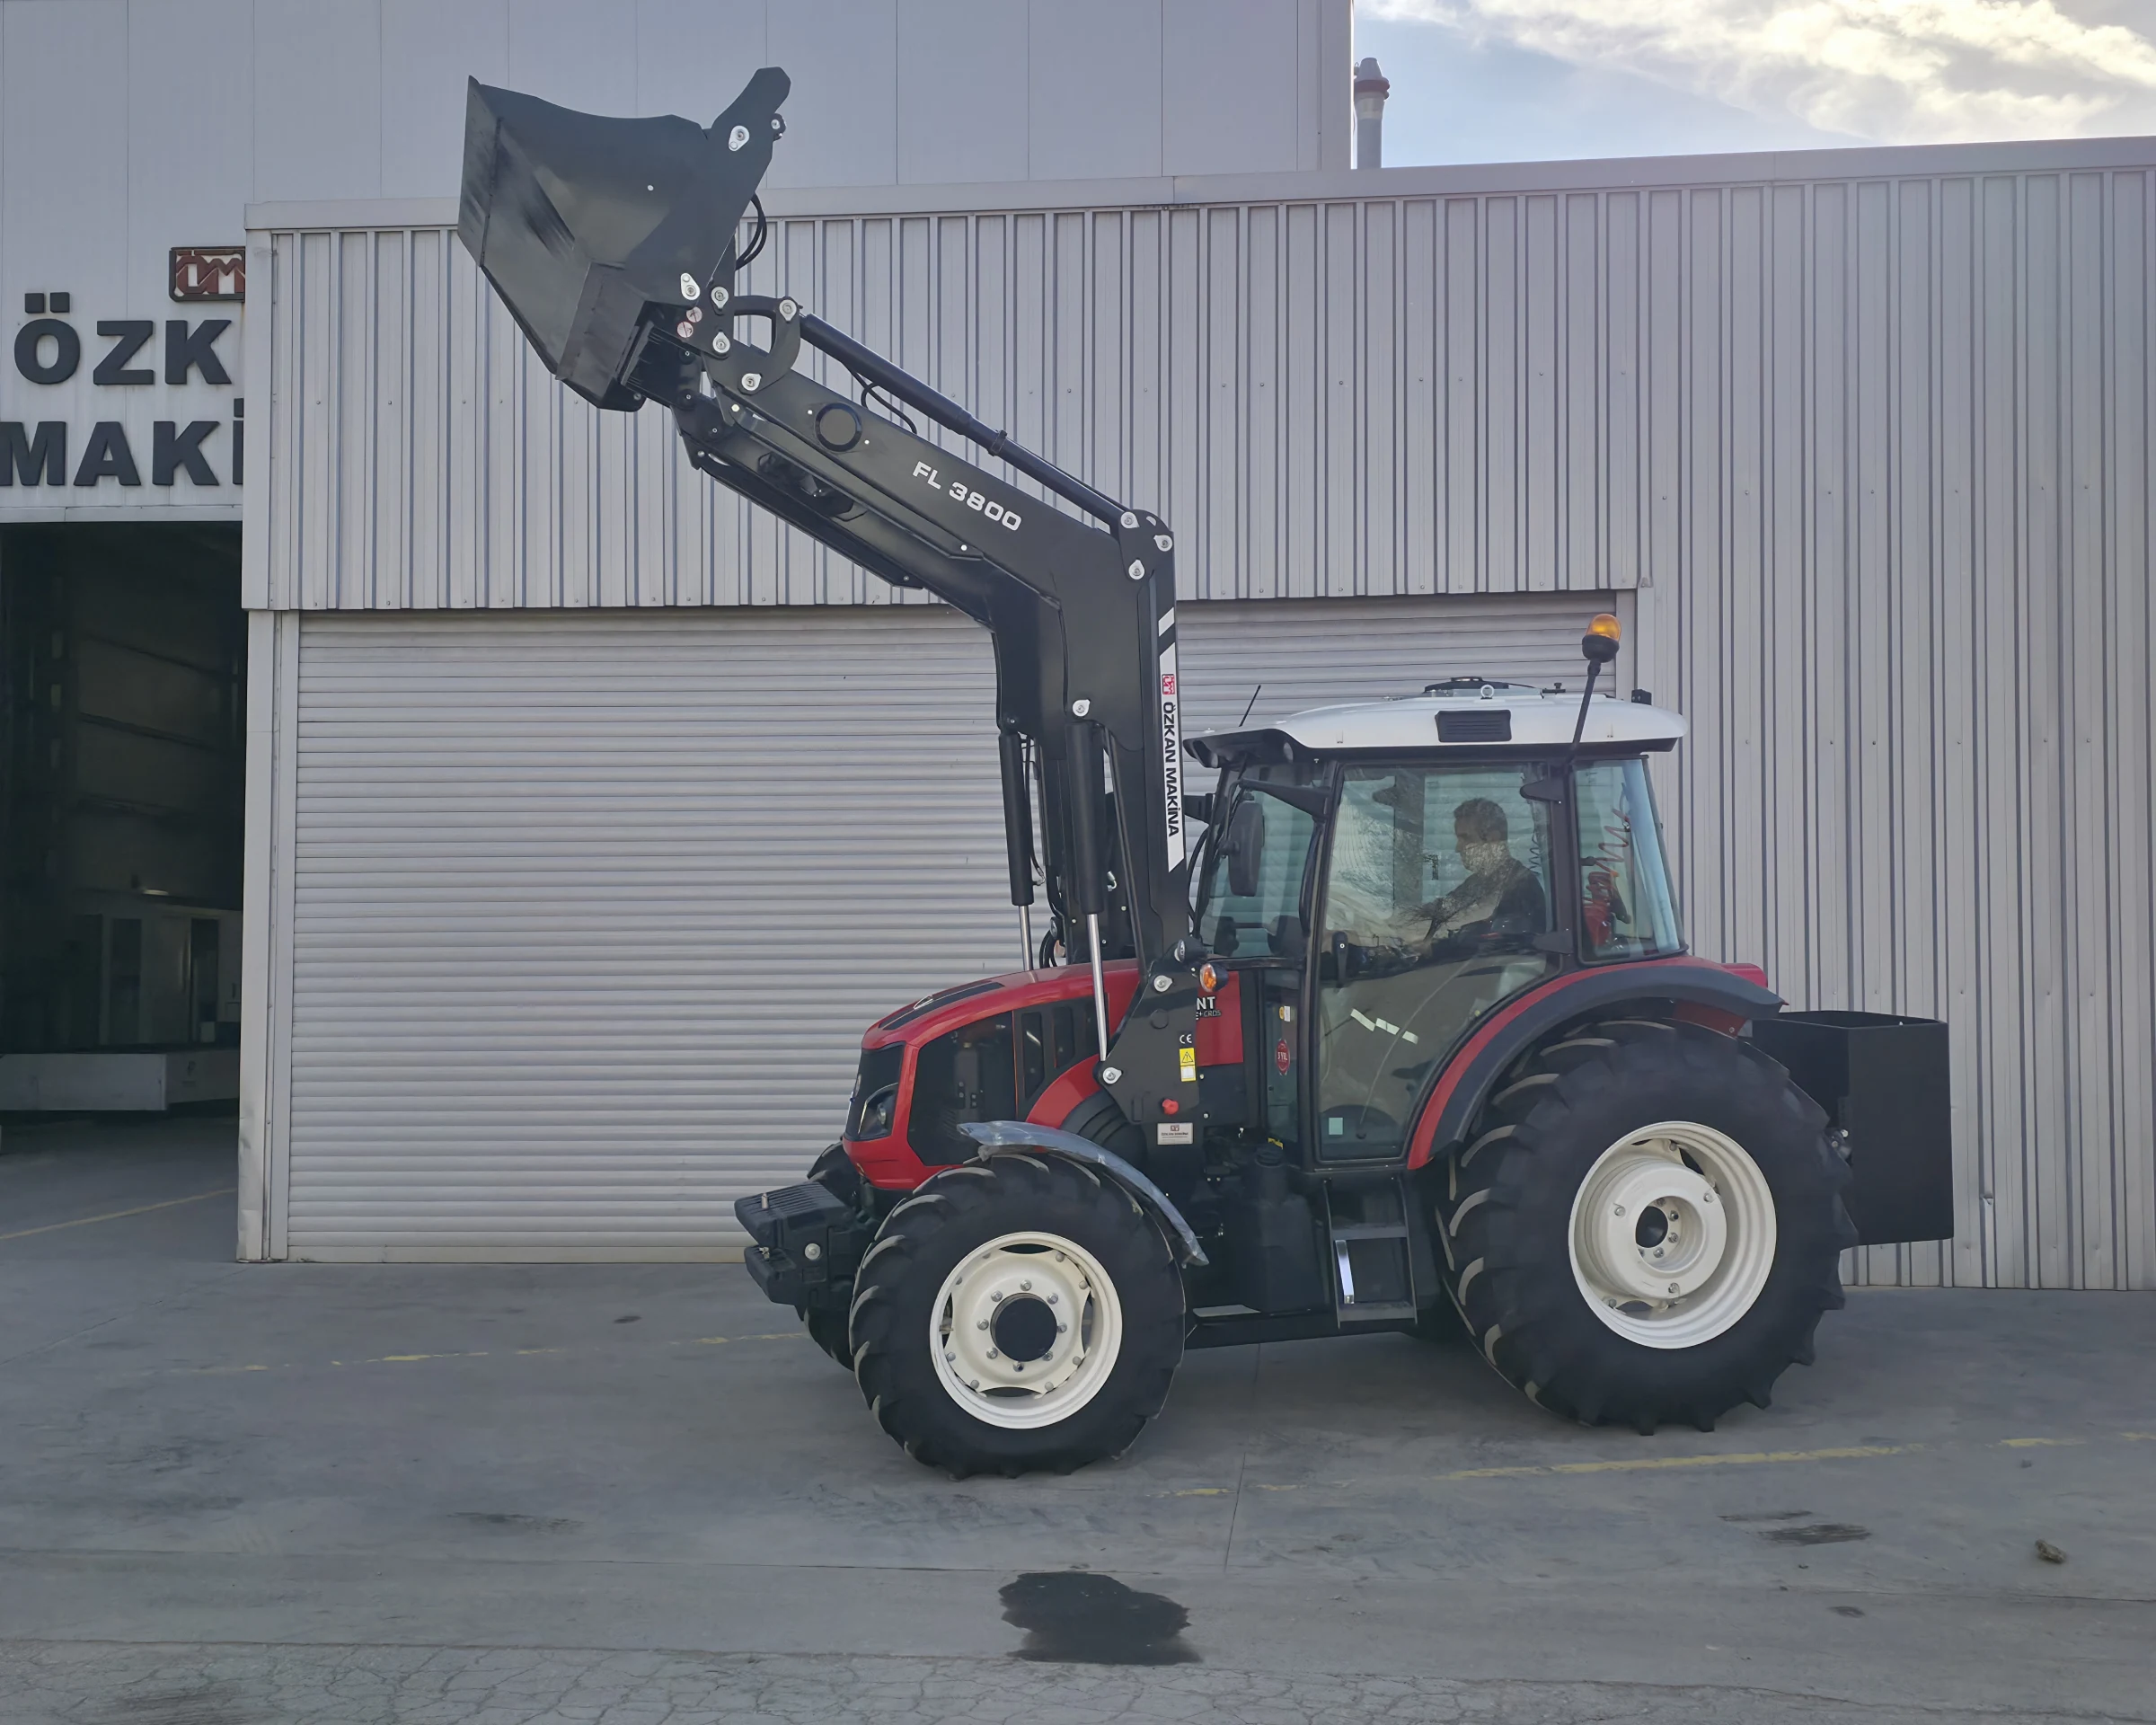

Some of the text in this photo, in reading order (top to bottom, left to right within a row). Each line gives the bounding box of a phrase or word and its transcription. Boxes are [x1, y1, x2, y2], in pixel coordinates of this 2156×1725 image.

[13, 291, 233, 385] ÖZK
[912, 460, 1022, 531] FL 3800
[1163, 702, 1180, 837] ÖZKAN MAKİNA
[1179, 1033, 1192, 1044] CE
